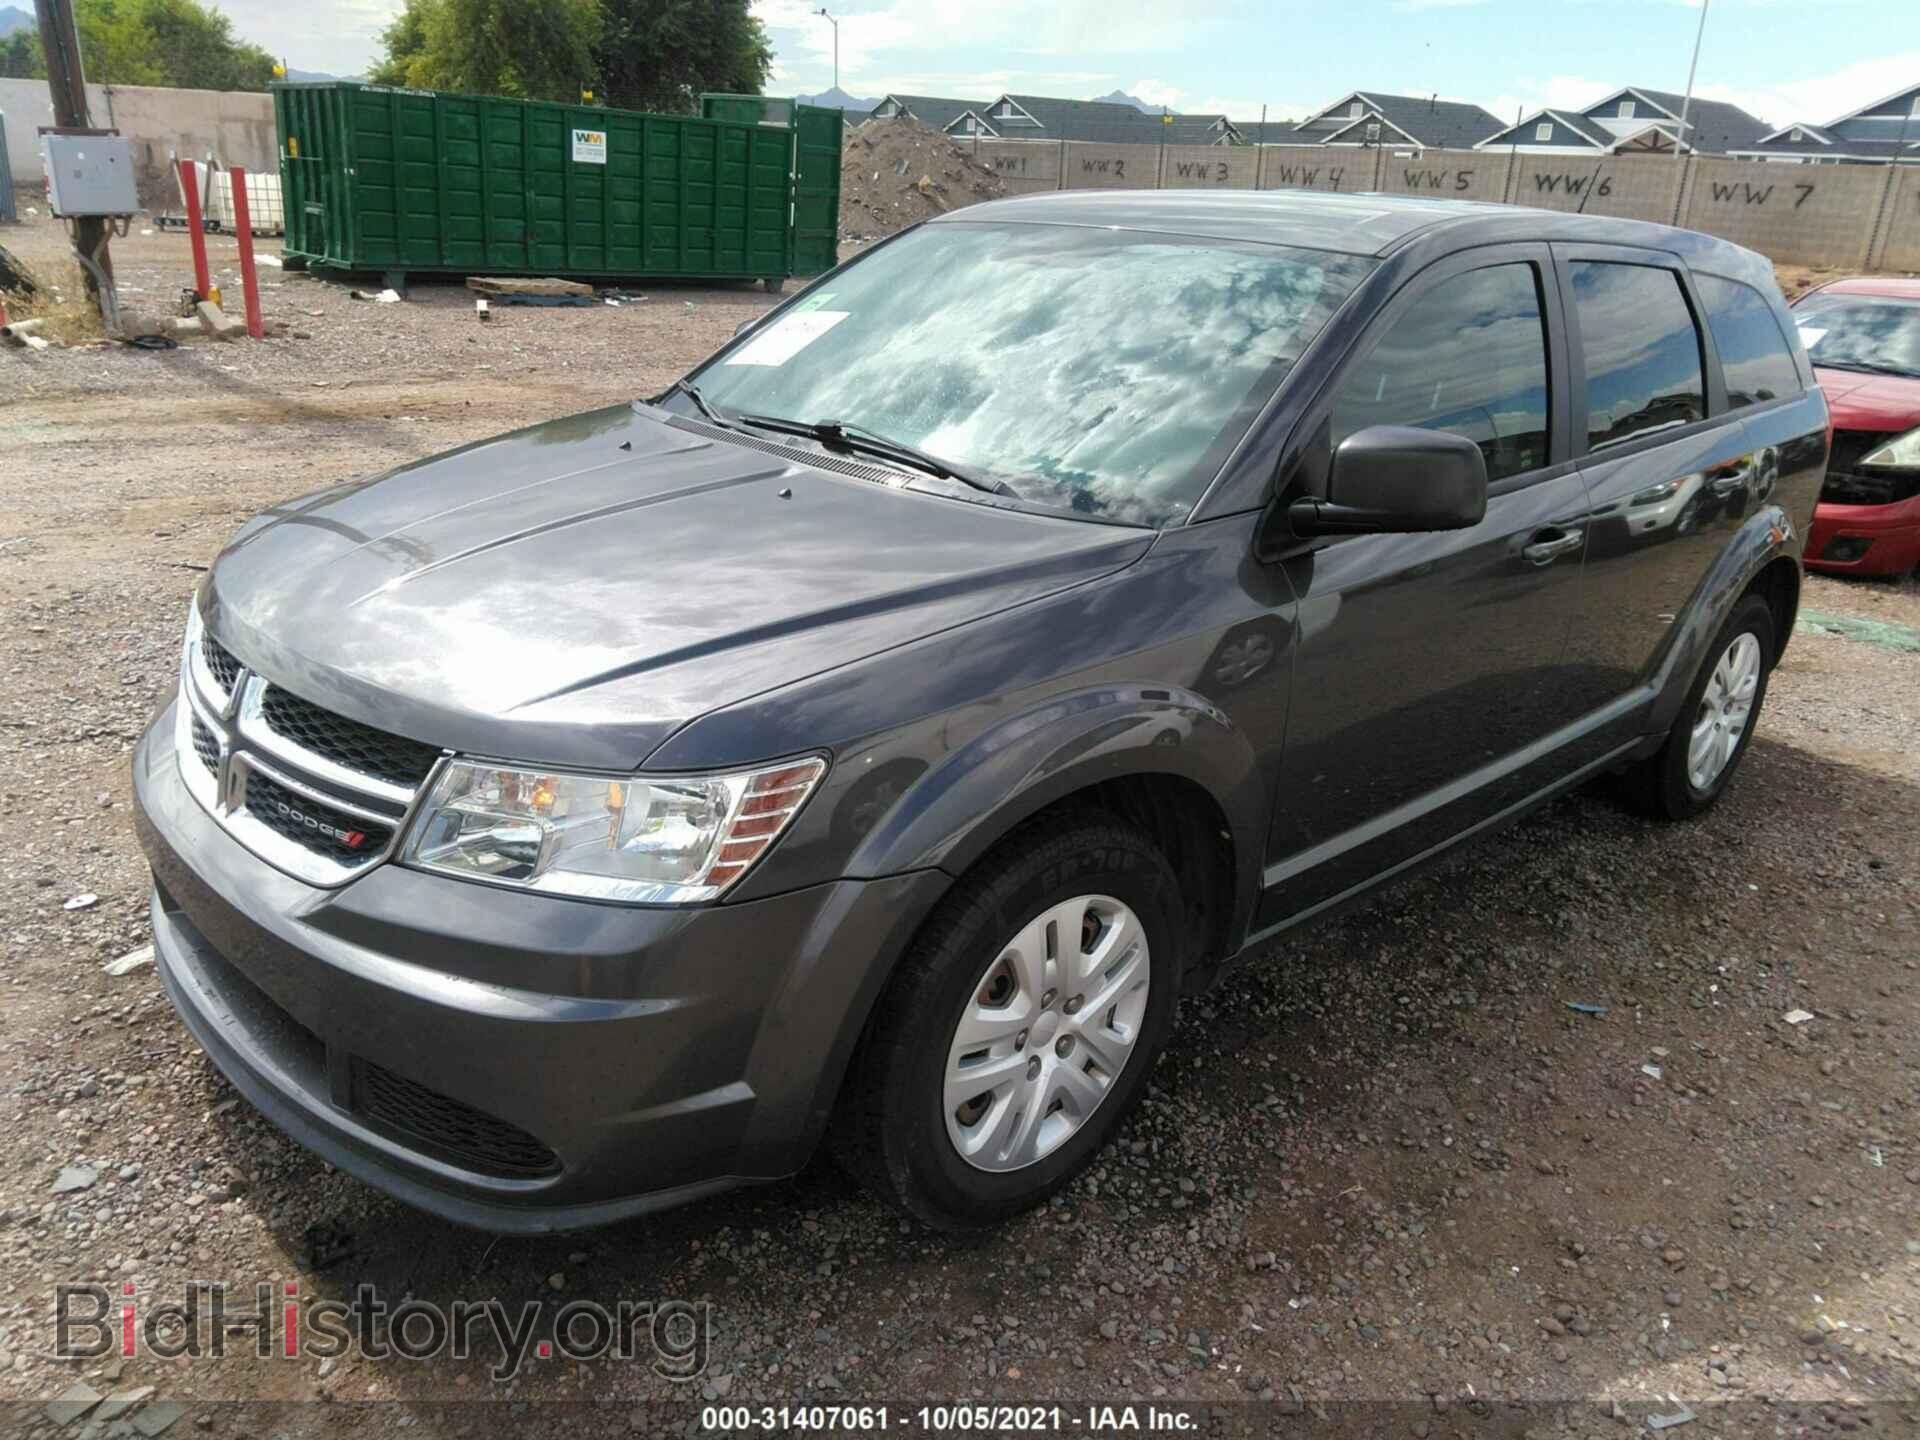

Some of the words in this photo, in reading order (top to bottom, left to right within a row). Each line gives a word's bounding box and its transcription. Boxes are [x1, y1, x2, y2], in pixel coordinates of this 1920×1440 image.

[575, 131, 603, 145] WM
[994, 156, 1017, 170] WW
[1021, 158, 1026, 172] 1
[1082, 159, 1112, 174] WW
[1115, 159, 1125, 179] 2
[1177, 162, 1209, 179] WW
[1216, 162, 1229, 182] 3
[1280, 164, 1320, 187] WW
[1329, 167, 1345, 192] 4
[1403, 169, 1449, 189] WW
[1455, 170, 1474, 191] 5
[1534, 173, 1588, 195] WW
[1596, 175, 1612, 196] 6
[1712, 181, 1774, 205] WW
[1793, 184, 1815, 208] 7
[277, 802, 351, 842] DODGE
